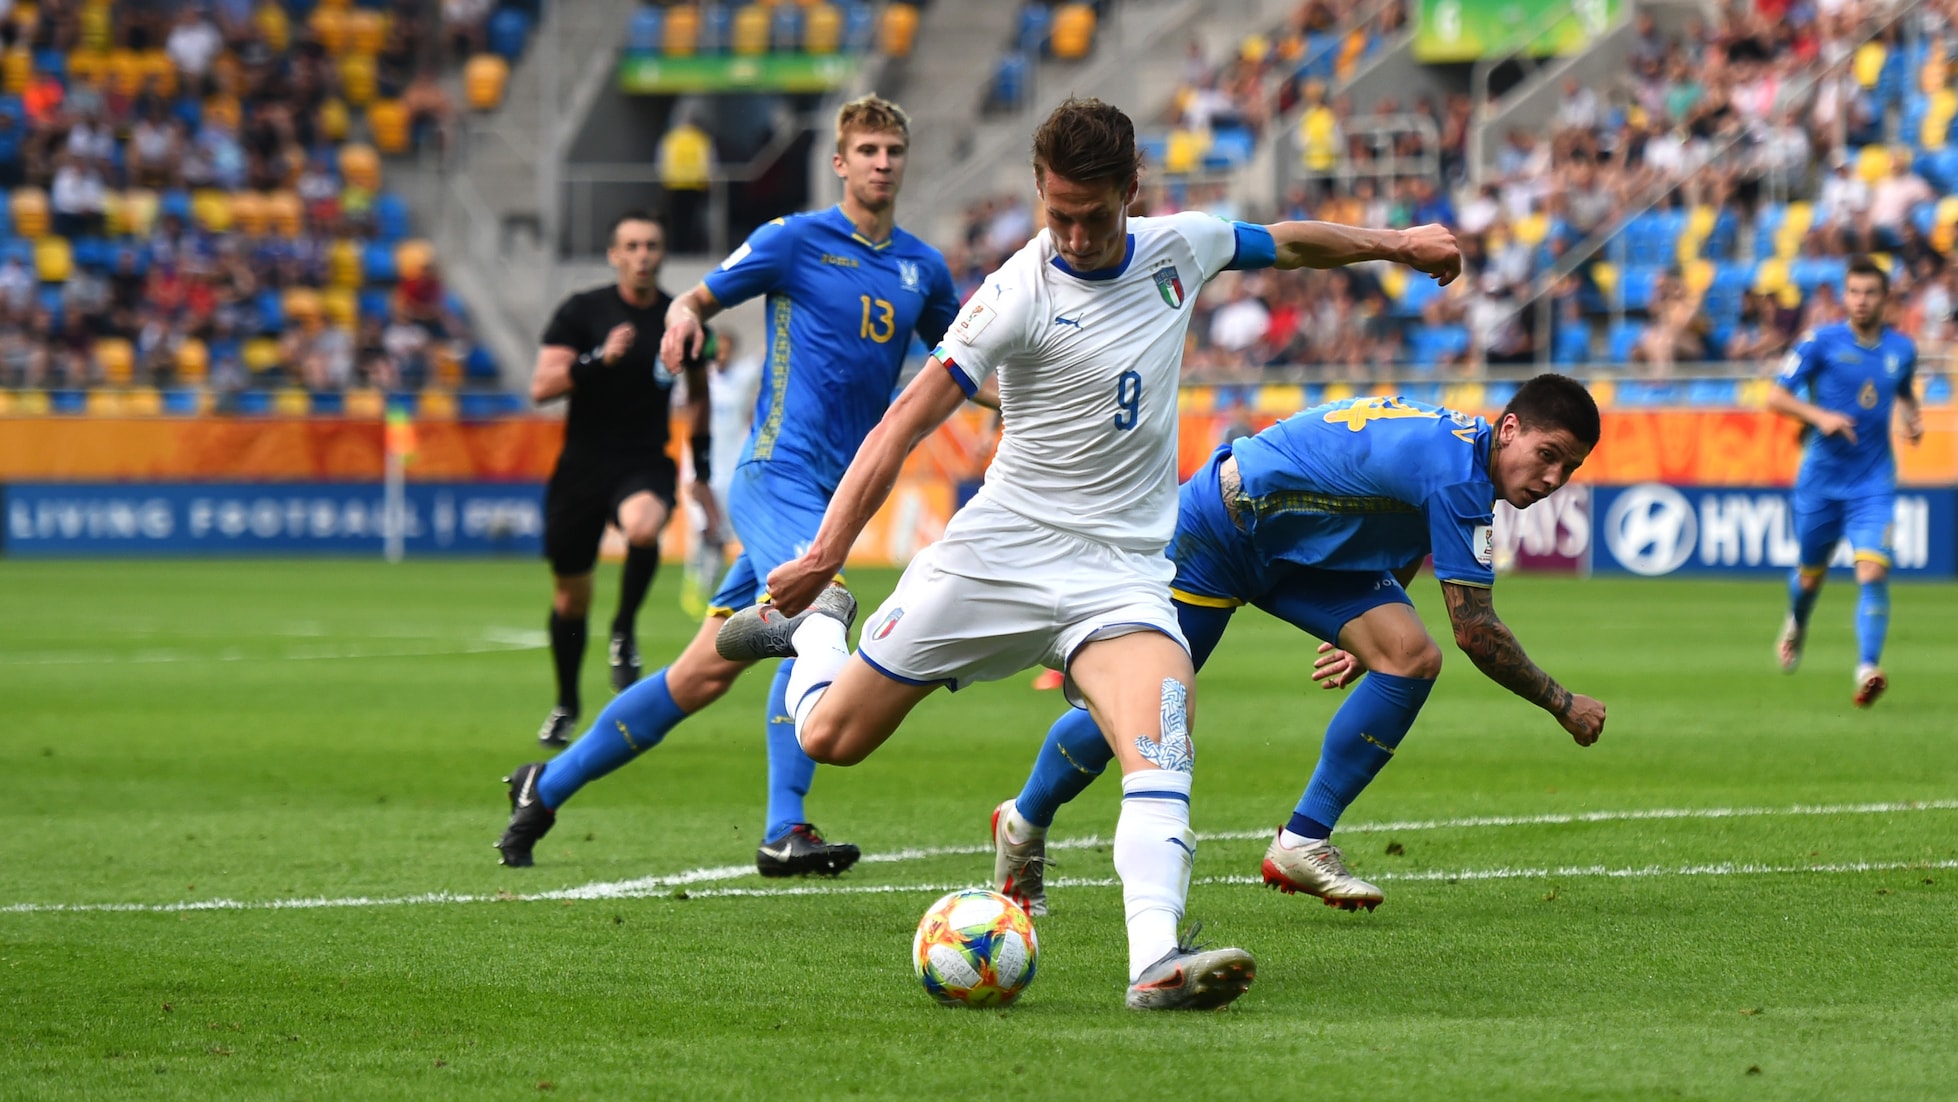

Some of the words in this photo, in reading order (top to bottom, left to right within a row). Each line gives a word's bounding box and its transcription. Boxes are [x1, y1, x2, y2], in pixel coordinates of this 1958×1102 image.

[860, 294, 896, 344] 13
[1114, 370, 1142, 431] 9
[1858, 378, 1879, 411] 6
[9, 498, 174, 539] LIVING
[188, 498, 425, 539] FOOTBALL
